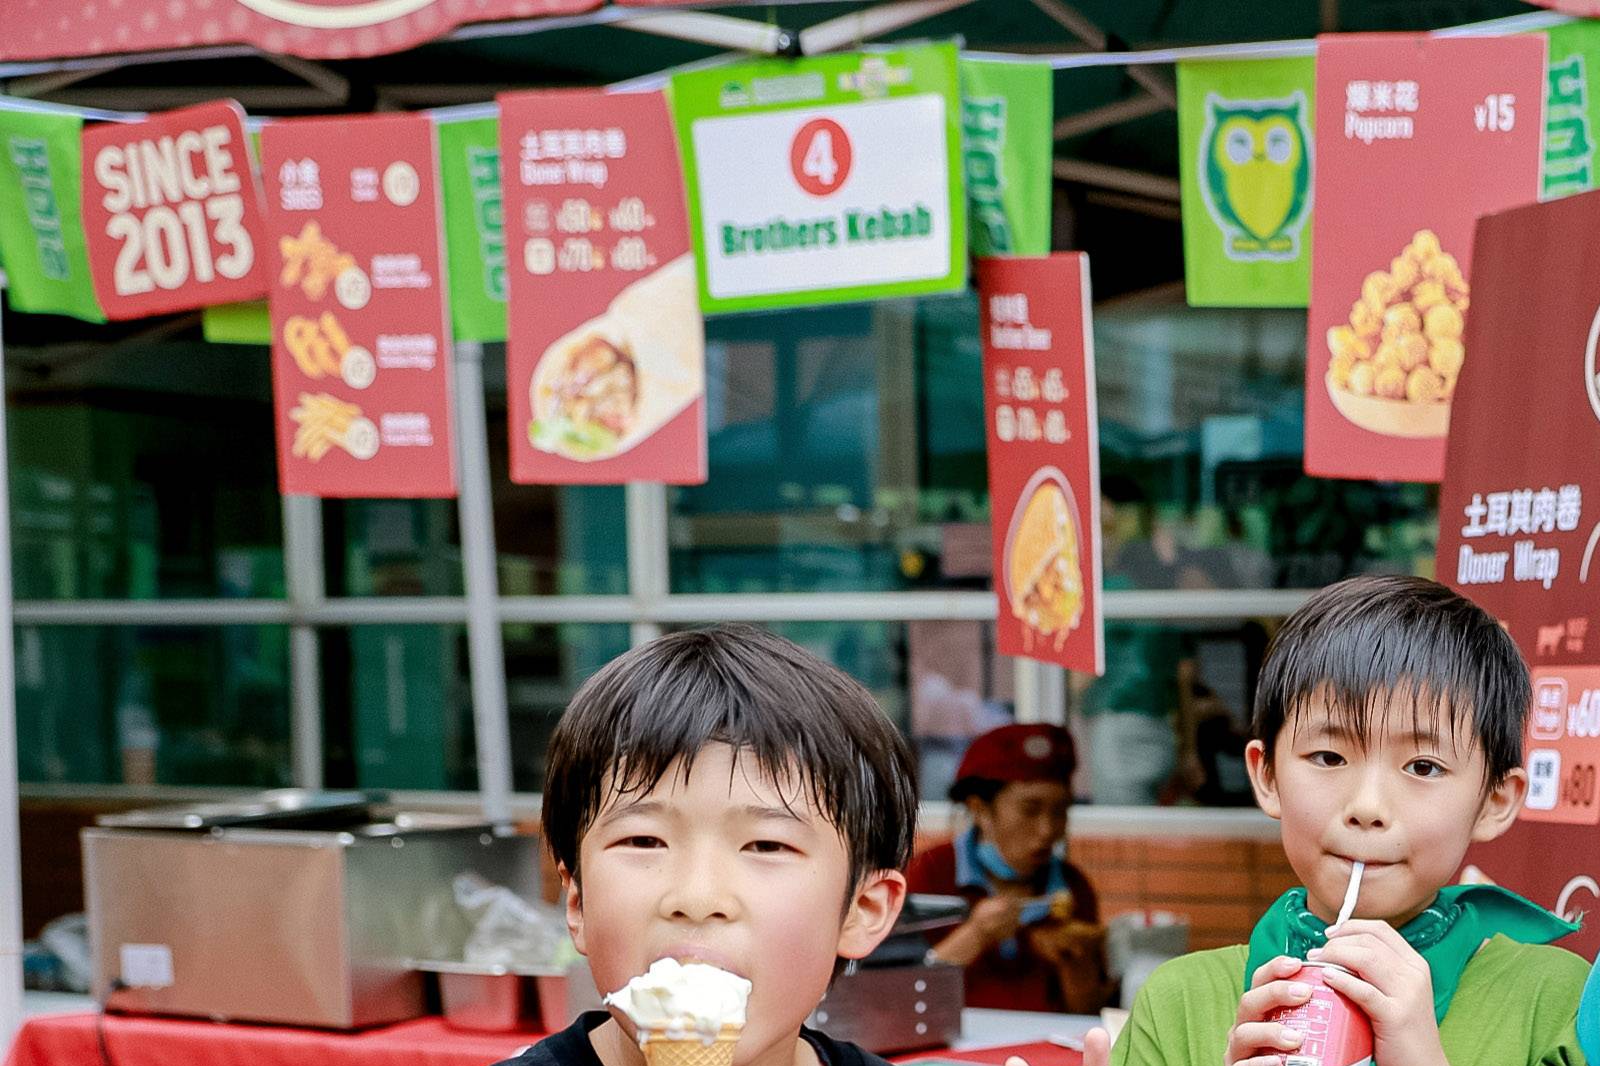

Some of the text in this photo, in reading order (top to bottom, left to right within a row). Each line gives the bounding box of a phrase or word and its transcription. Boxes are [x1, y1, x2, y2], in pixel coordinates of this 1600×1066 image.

[94, 124, 240, 213] SINCE
[802, 128, 839, 186] 4
[106, 193, 254, 296] 2013
[721, 203, 932, 256] Brothers Kebab
[1461, 484, 1581, 537] 土耳其肉卷
[1457, 540, 1560, 590] Doner Wrap
